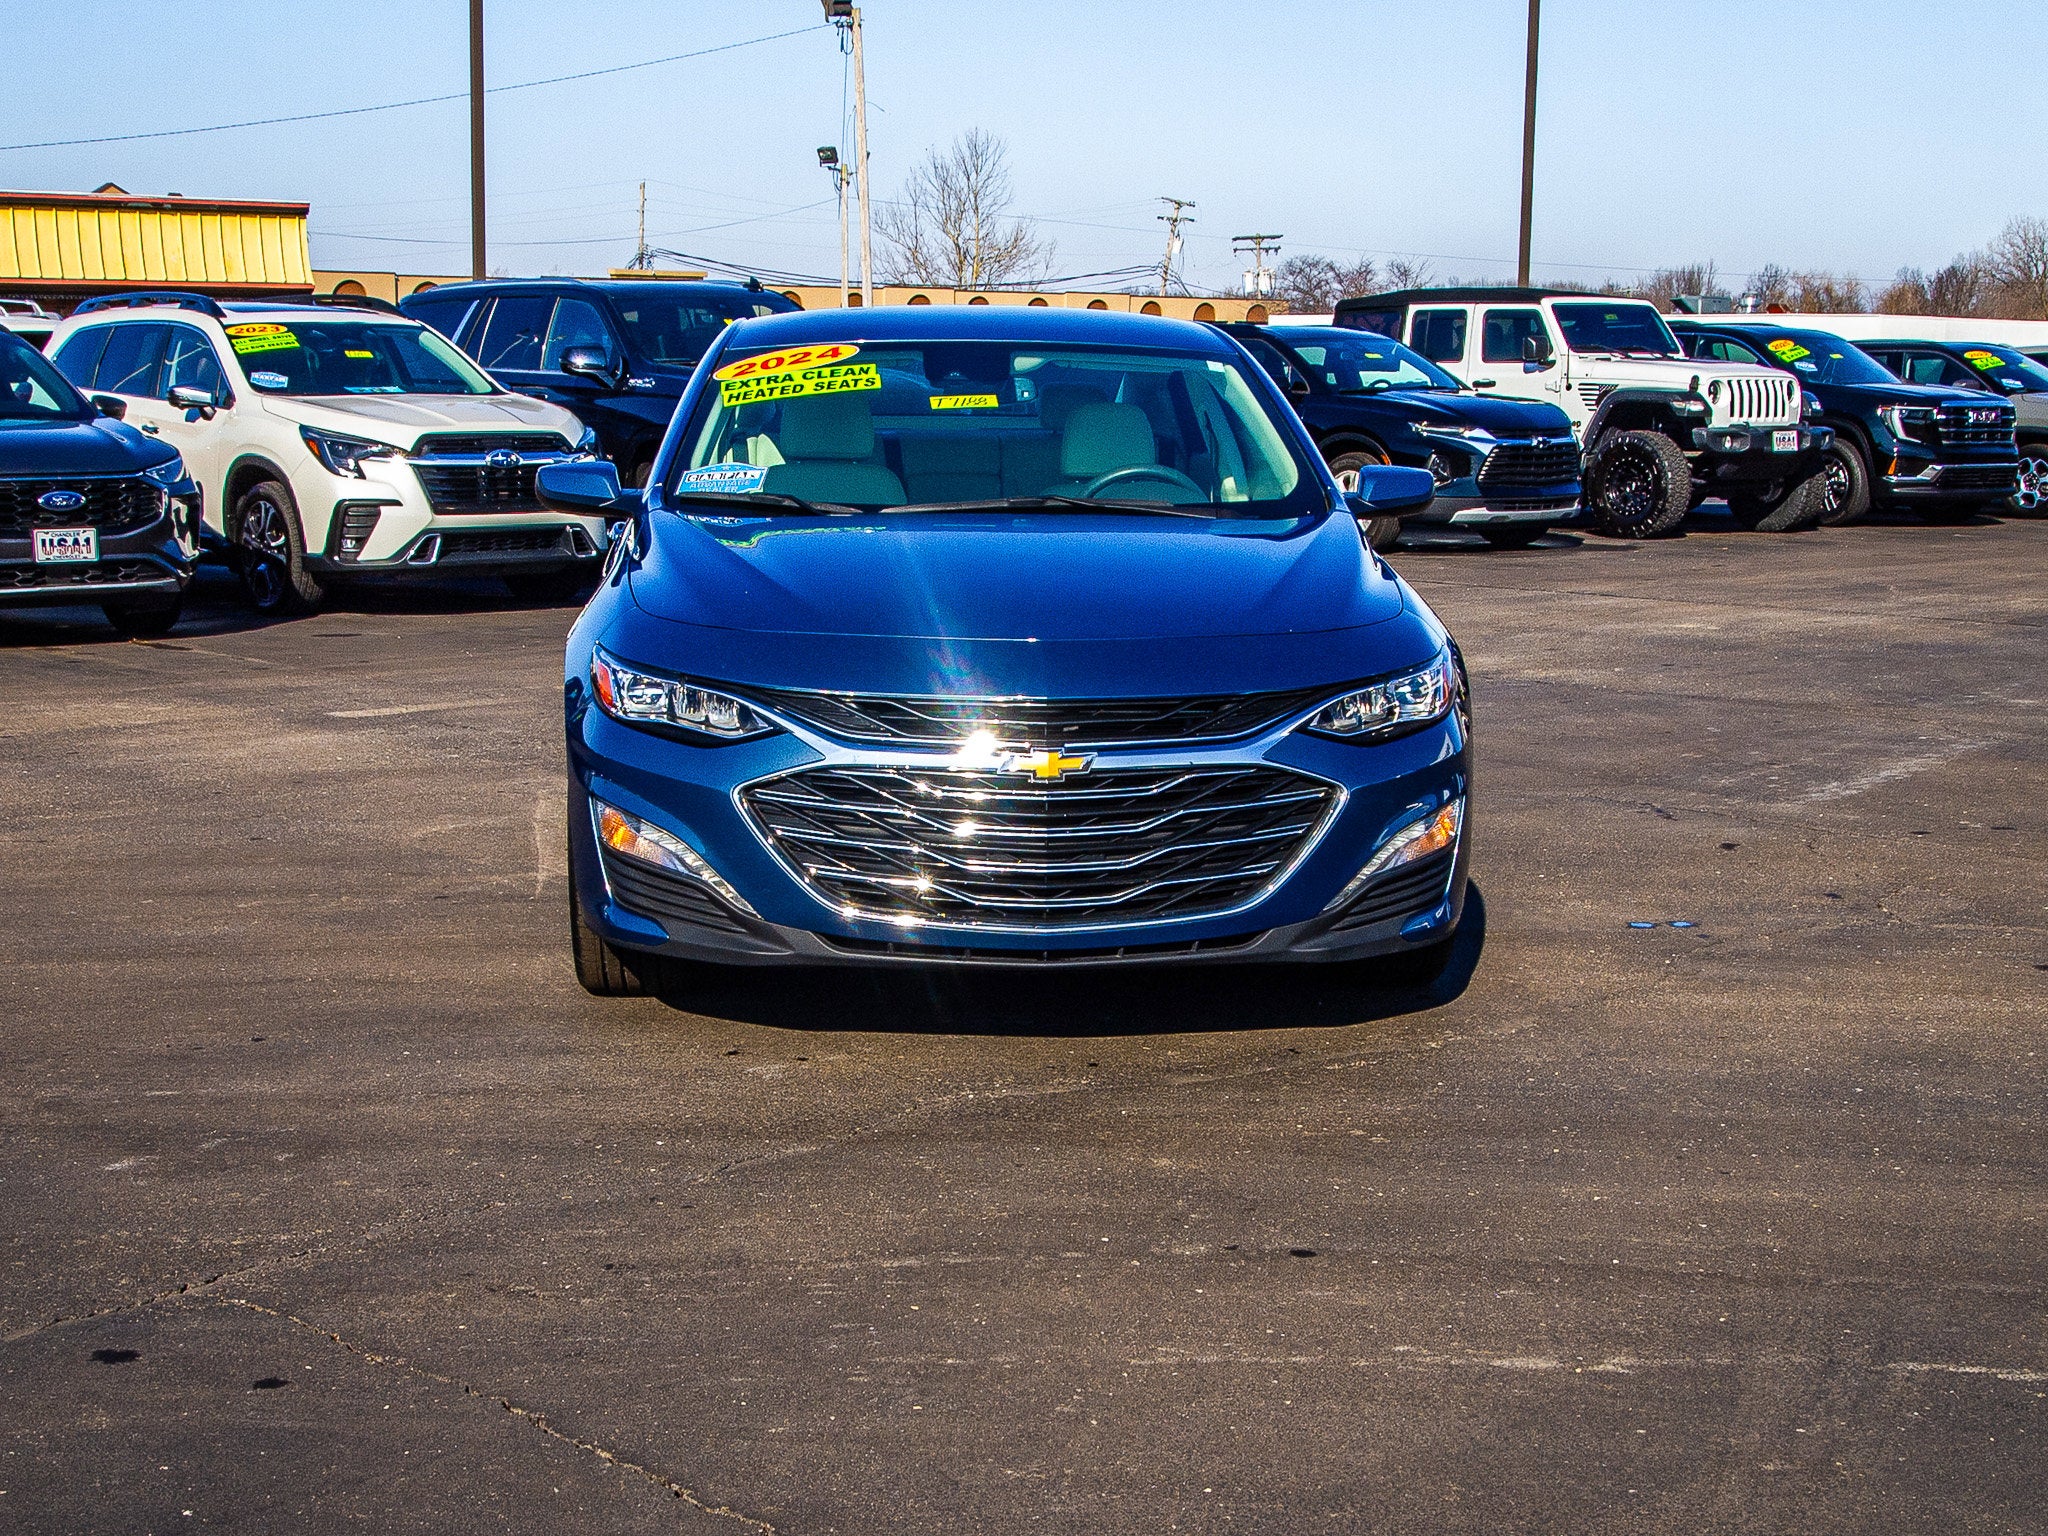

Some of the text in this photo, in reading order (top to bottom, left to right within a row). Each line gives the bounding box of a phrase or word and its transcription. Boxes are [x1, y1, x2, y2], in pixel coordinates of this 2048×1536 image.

[235, 326, 280, 334] 2023
[732, 346, 842, 378] 2024
[724, 366, 871, 392] EXTRA CLEAN
[727, 377, 876, 404] HEATED SEATS
[40, 537, 92, 556] USA1
